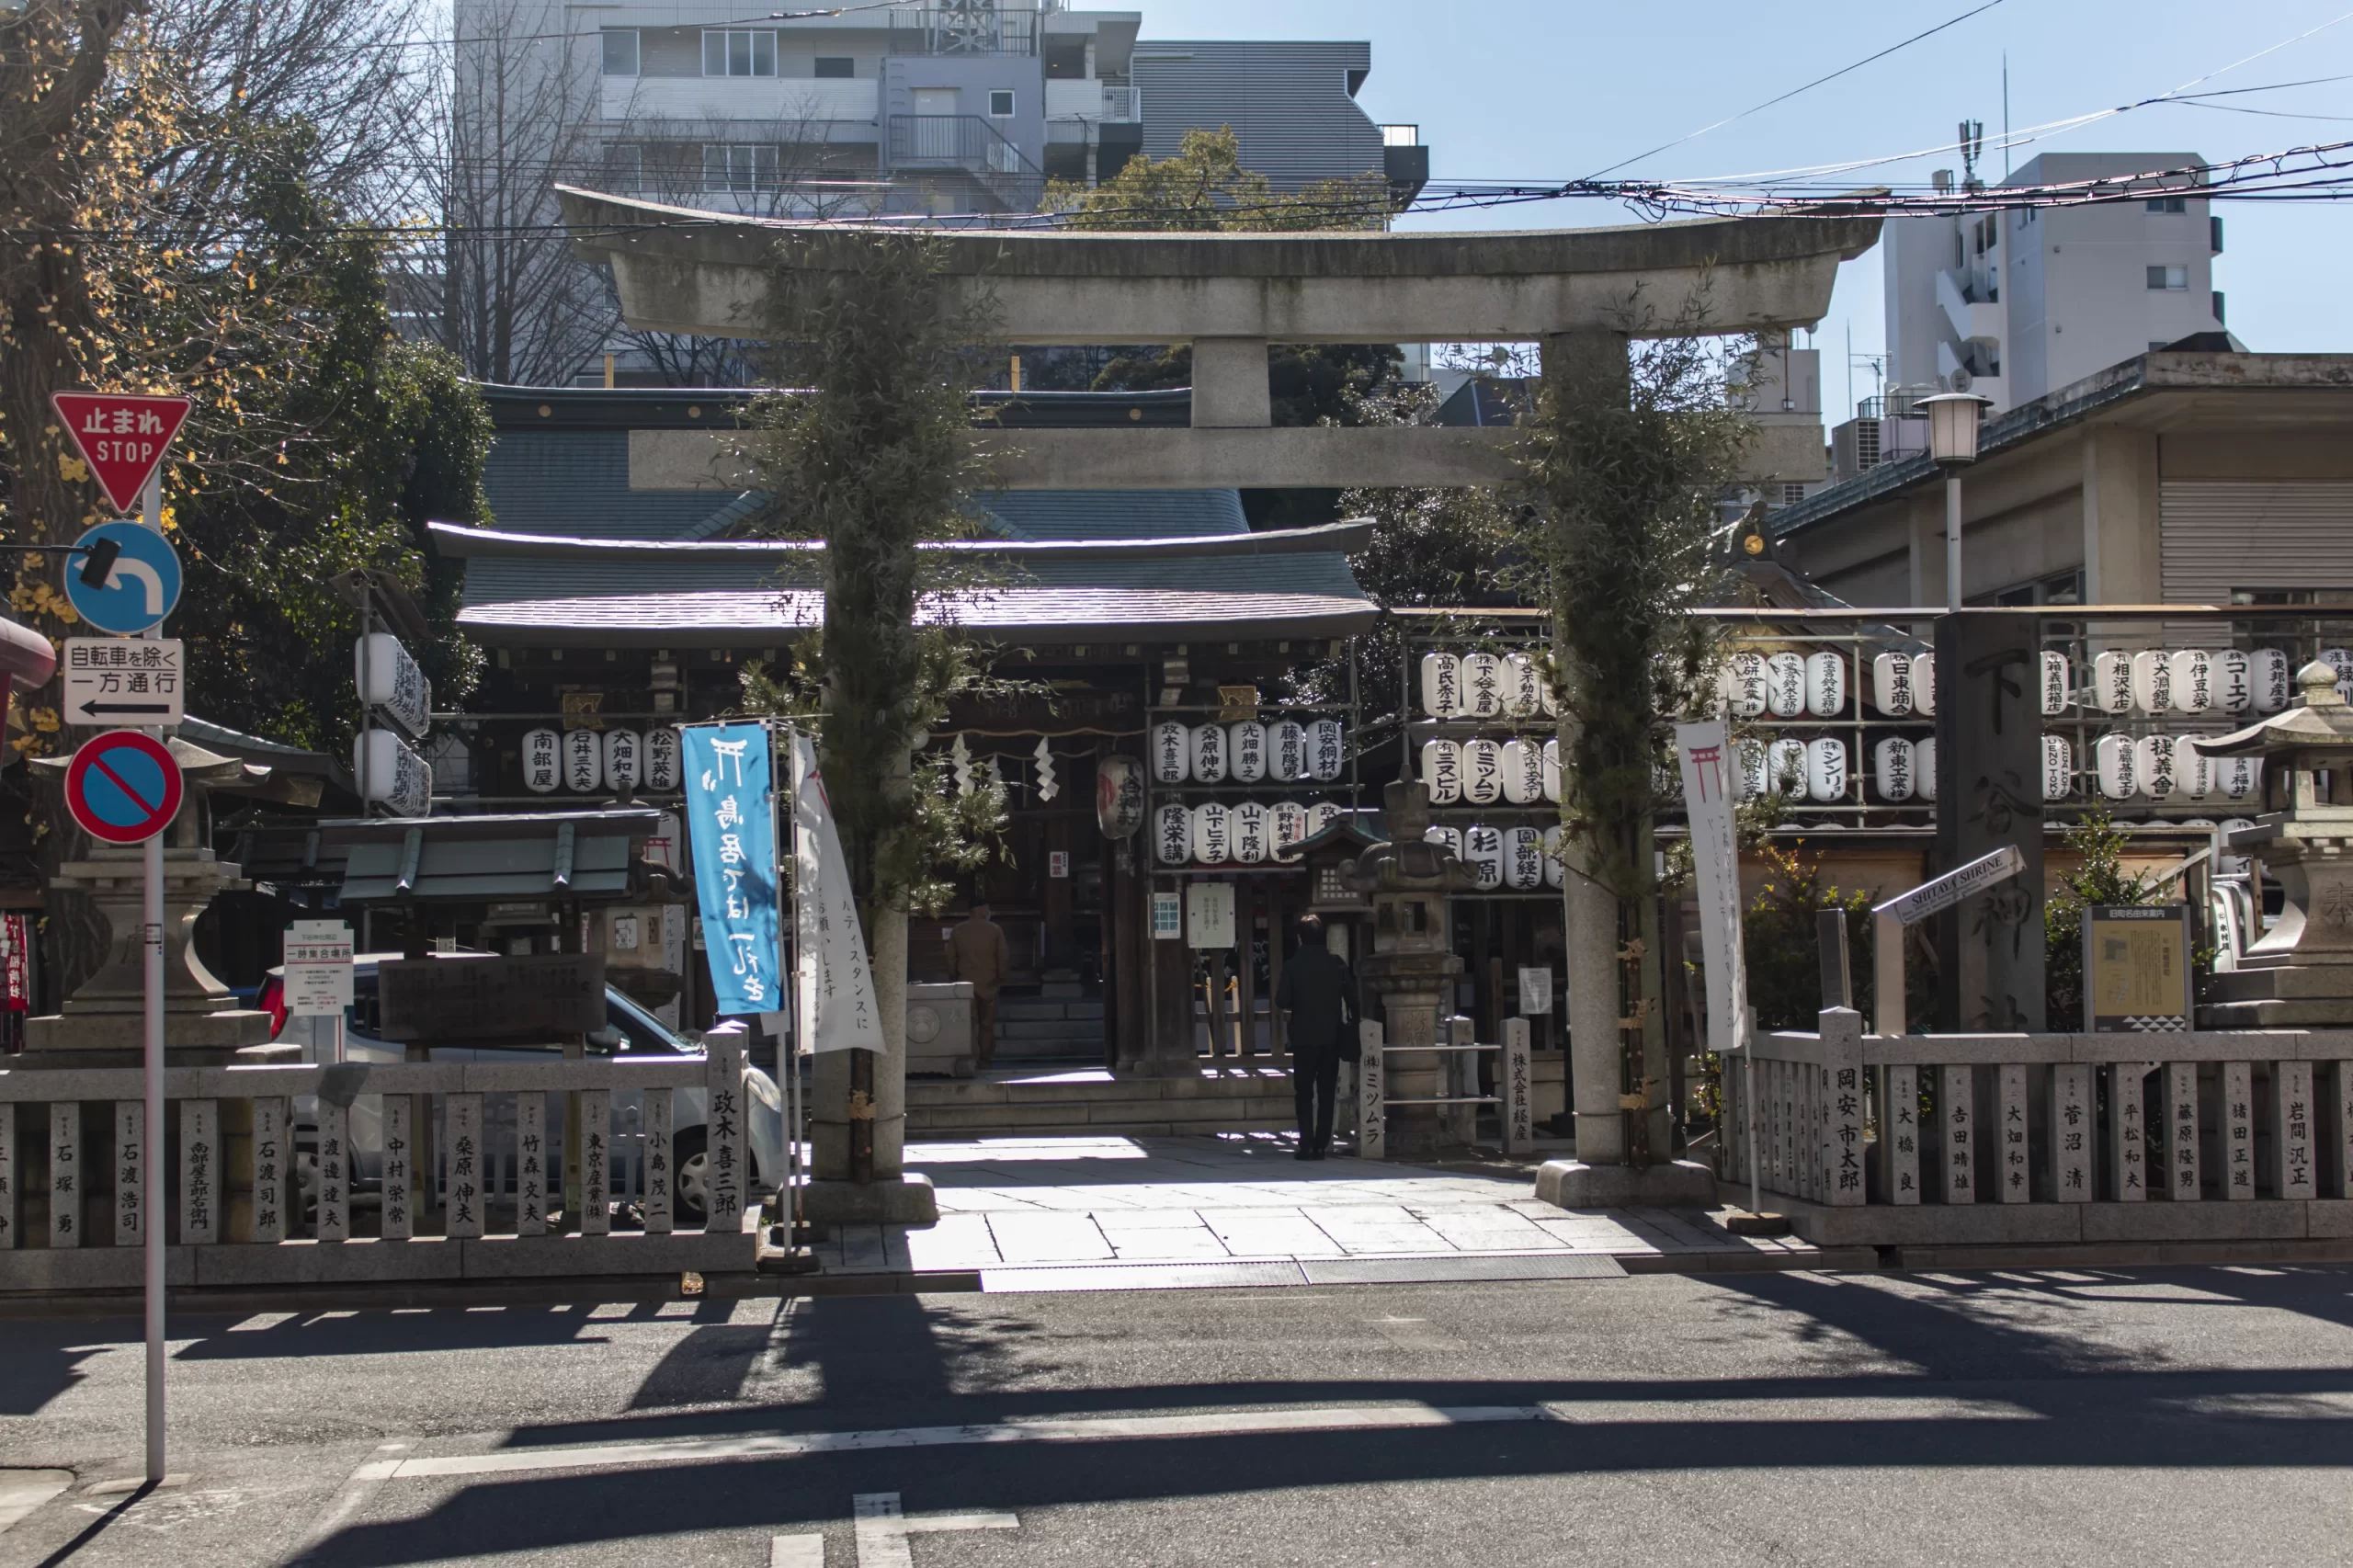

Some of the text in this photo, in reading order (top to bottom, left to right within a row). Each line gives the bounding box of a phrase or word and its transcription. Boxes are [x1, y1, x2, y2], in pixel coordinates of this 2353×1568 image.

[82, 407, 165, 436] 止まれ
[97, 441, 153, 462] STOP
[71, 645, 176, 669] 自転車を除く
[71, 672, 177, 694] 一方通行
[532, 732, 553, 787] 南部屋
[1161, 724, 1180, 780] 政木喜三郎
[1199, 726, 1221, 779] 桑原伸夫
[1241, 805, 1260, 861] 山下隆利
[1911, 856, 2003, 905] SHITAYA SHRINE
[287, 949, 351, 960] 一時集合場所
[712, 1094, 738, 1218] 政木喜三郎
[1836, 1068, 1860, 1192] 岡安市太郎
[1897, 1107, 1916, 1192] 大橋良
[2006, 1105, 2025, 1189] 大畑和幸
[2063, 1105, 2084, 1189] 菅沼清
[2122, 1104, 2142, 1188] 平松和夫
[2177, 1104, 2195, 1188] 藤原隆男
[2232, 1103, 2250, 1187] 猪田正道
[55, 1144, 76, 1233] 石塚勇
[119, 1142, 140, 1232] 石渡浩司
[256, 1140, 278, 1228] 石渡司郎
[453, 1135, 475, 1223] 桑原伸夫
[522, 1134, 541, 1222] 竹森文夫
[648, 1131, 669, 1217] 小島茂二
